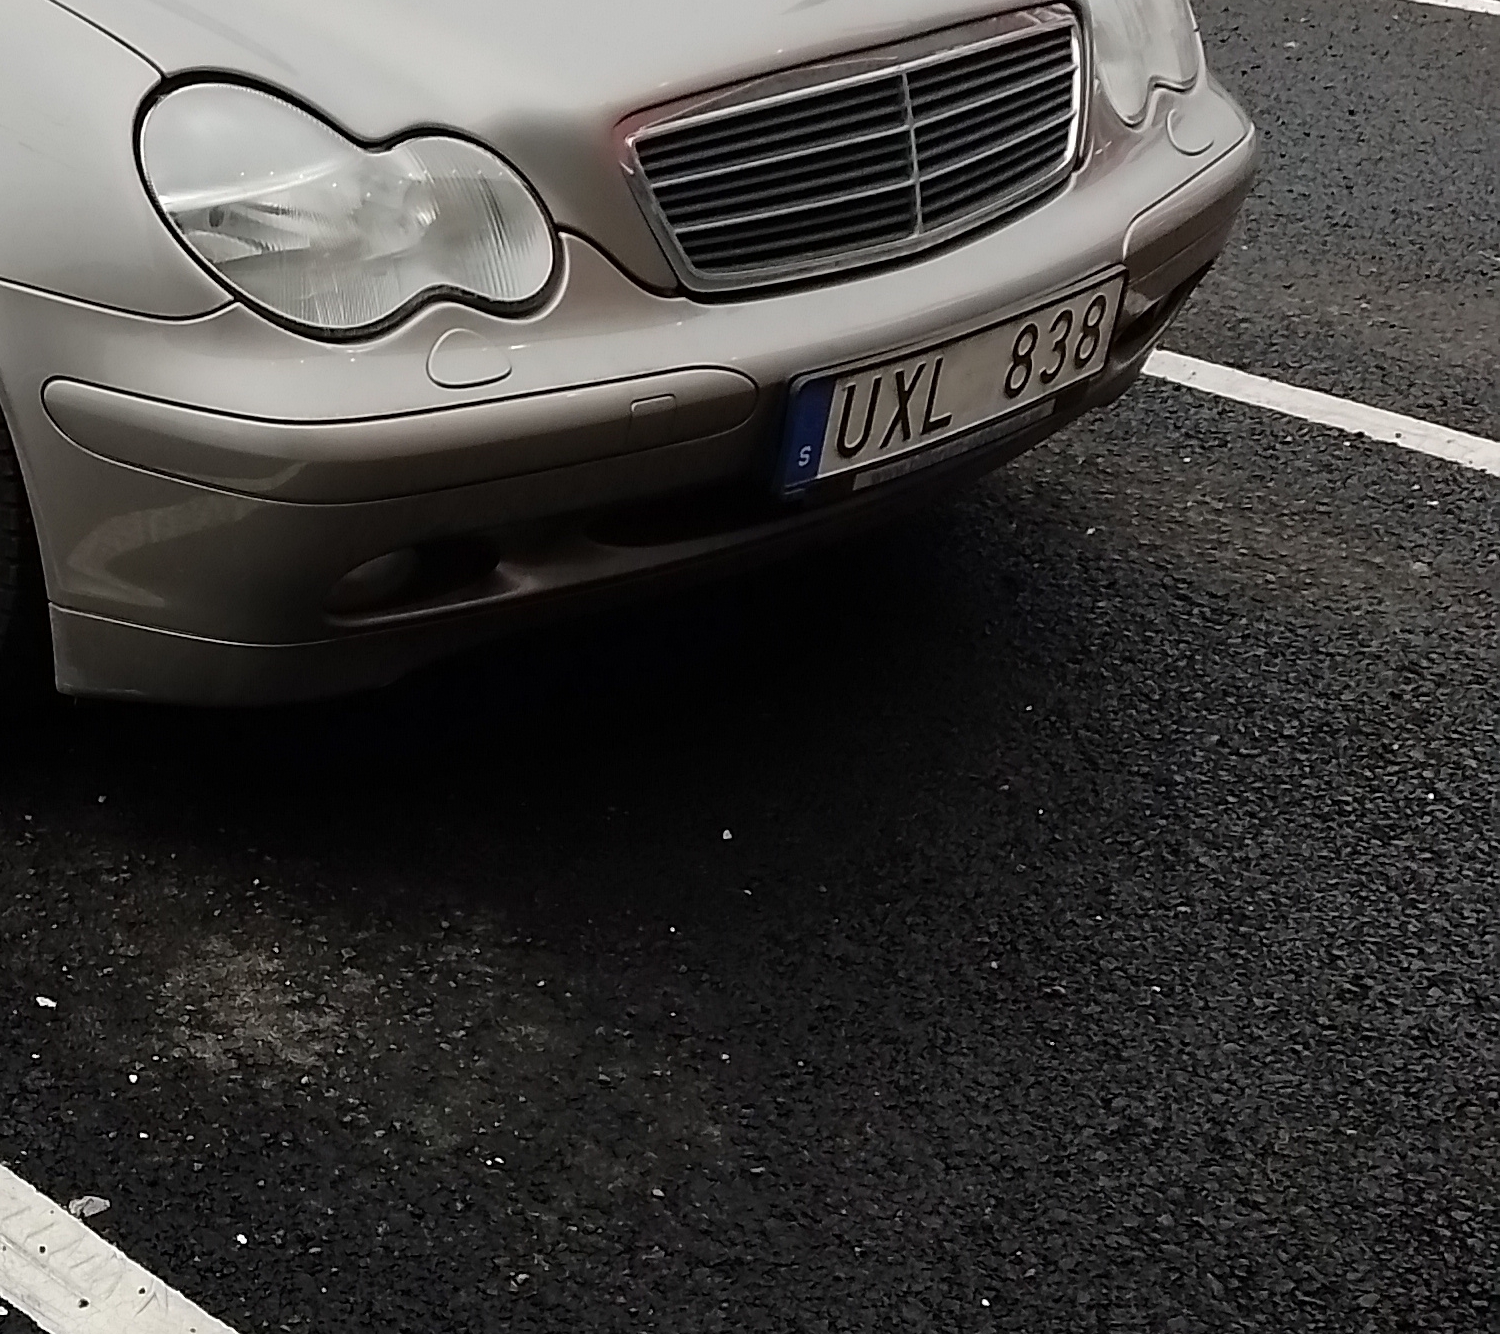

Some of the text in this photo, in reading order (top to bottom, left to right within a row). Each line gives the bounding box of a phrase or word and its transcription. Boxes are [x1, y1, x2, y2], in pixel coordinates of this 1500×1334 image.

[836, 356, 953, 458] UXL
[1004, 293, 1108, 399] 838
[798, 445, 812, 467] S
